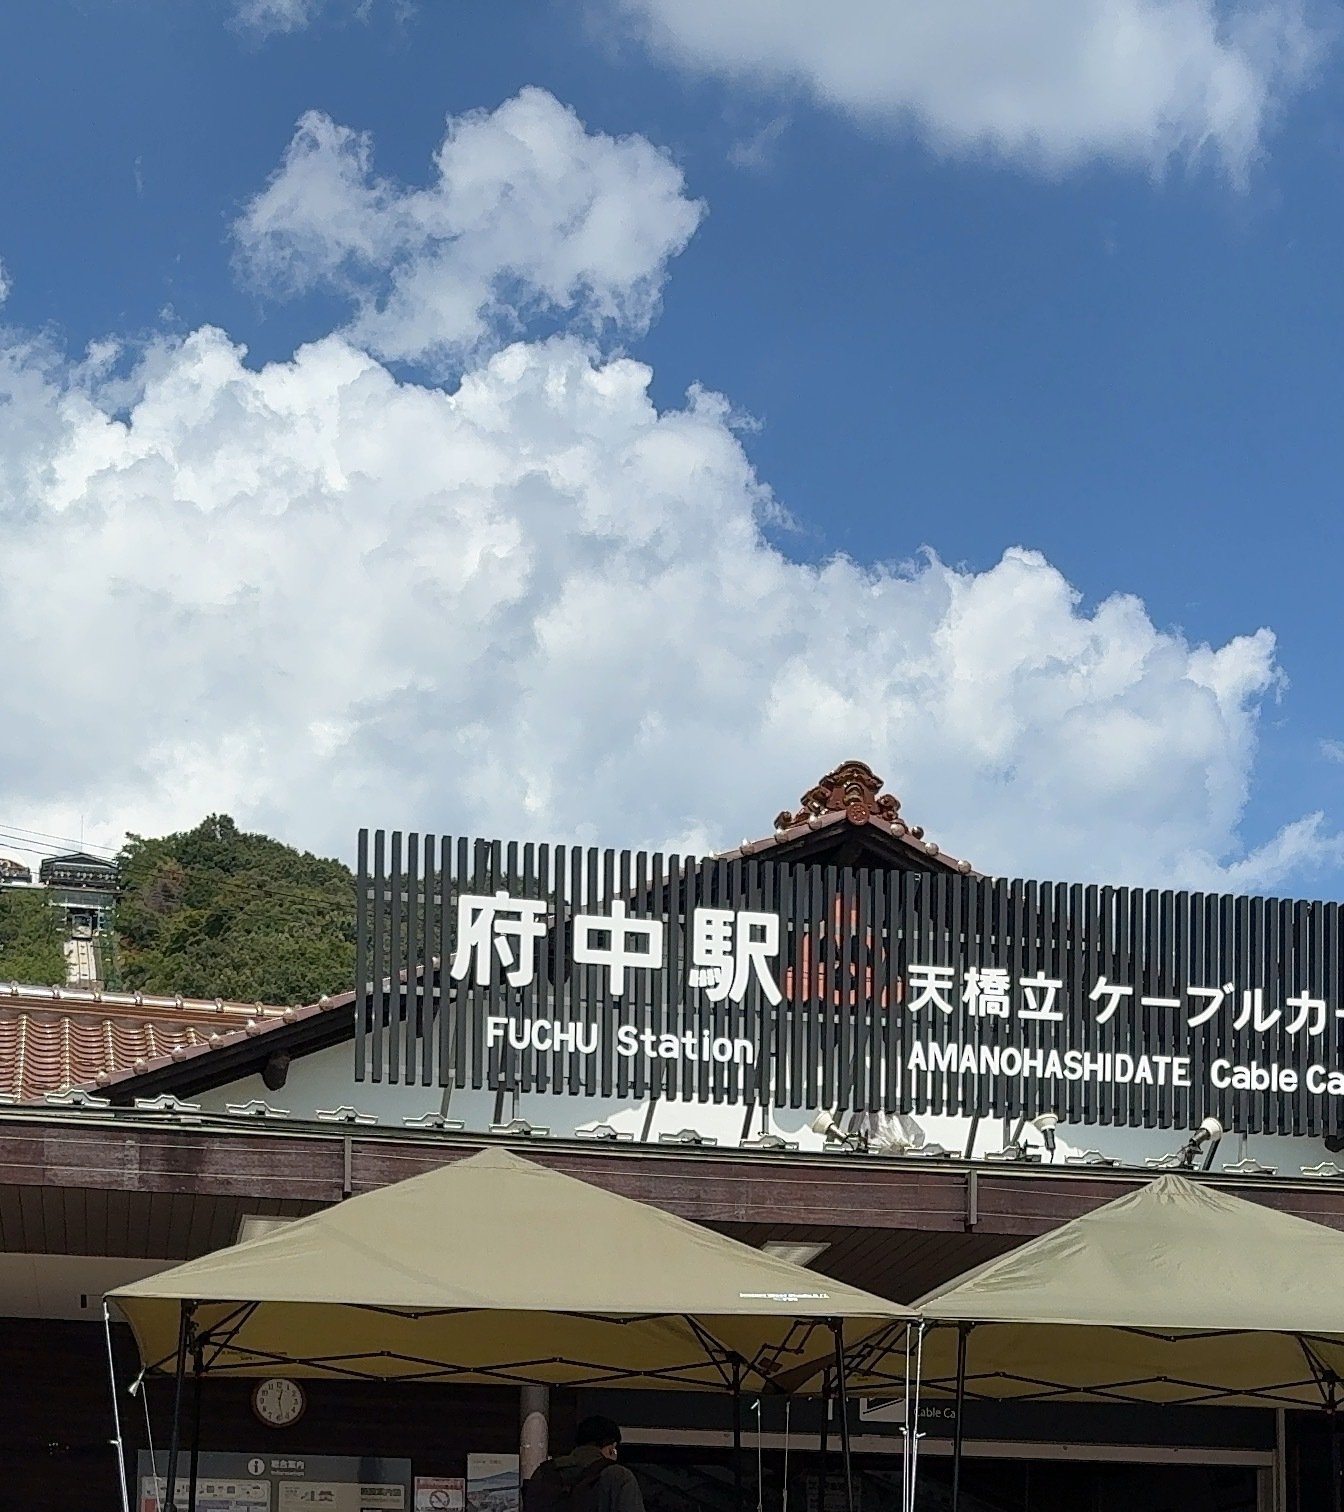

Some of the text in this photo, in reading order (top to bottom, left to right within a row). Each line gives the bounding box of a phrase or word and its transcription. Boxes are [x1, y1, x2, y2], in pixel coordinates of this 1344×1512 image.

[451, 891, 782, 1005] 府中駅
[906, 965, 1064, 1021] 天橋立
[486, 1016, 753, 1064] FUCHU Station
[907, 1041, 1191, 1088] AMANOHASHIDATE
[1211, 1058, 1296, 1094] Cable
[944, 1407, 957, 1418] Ca
